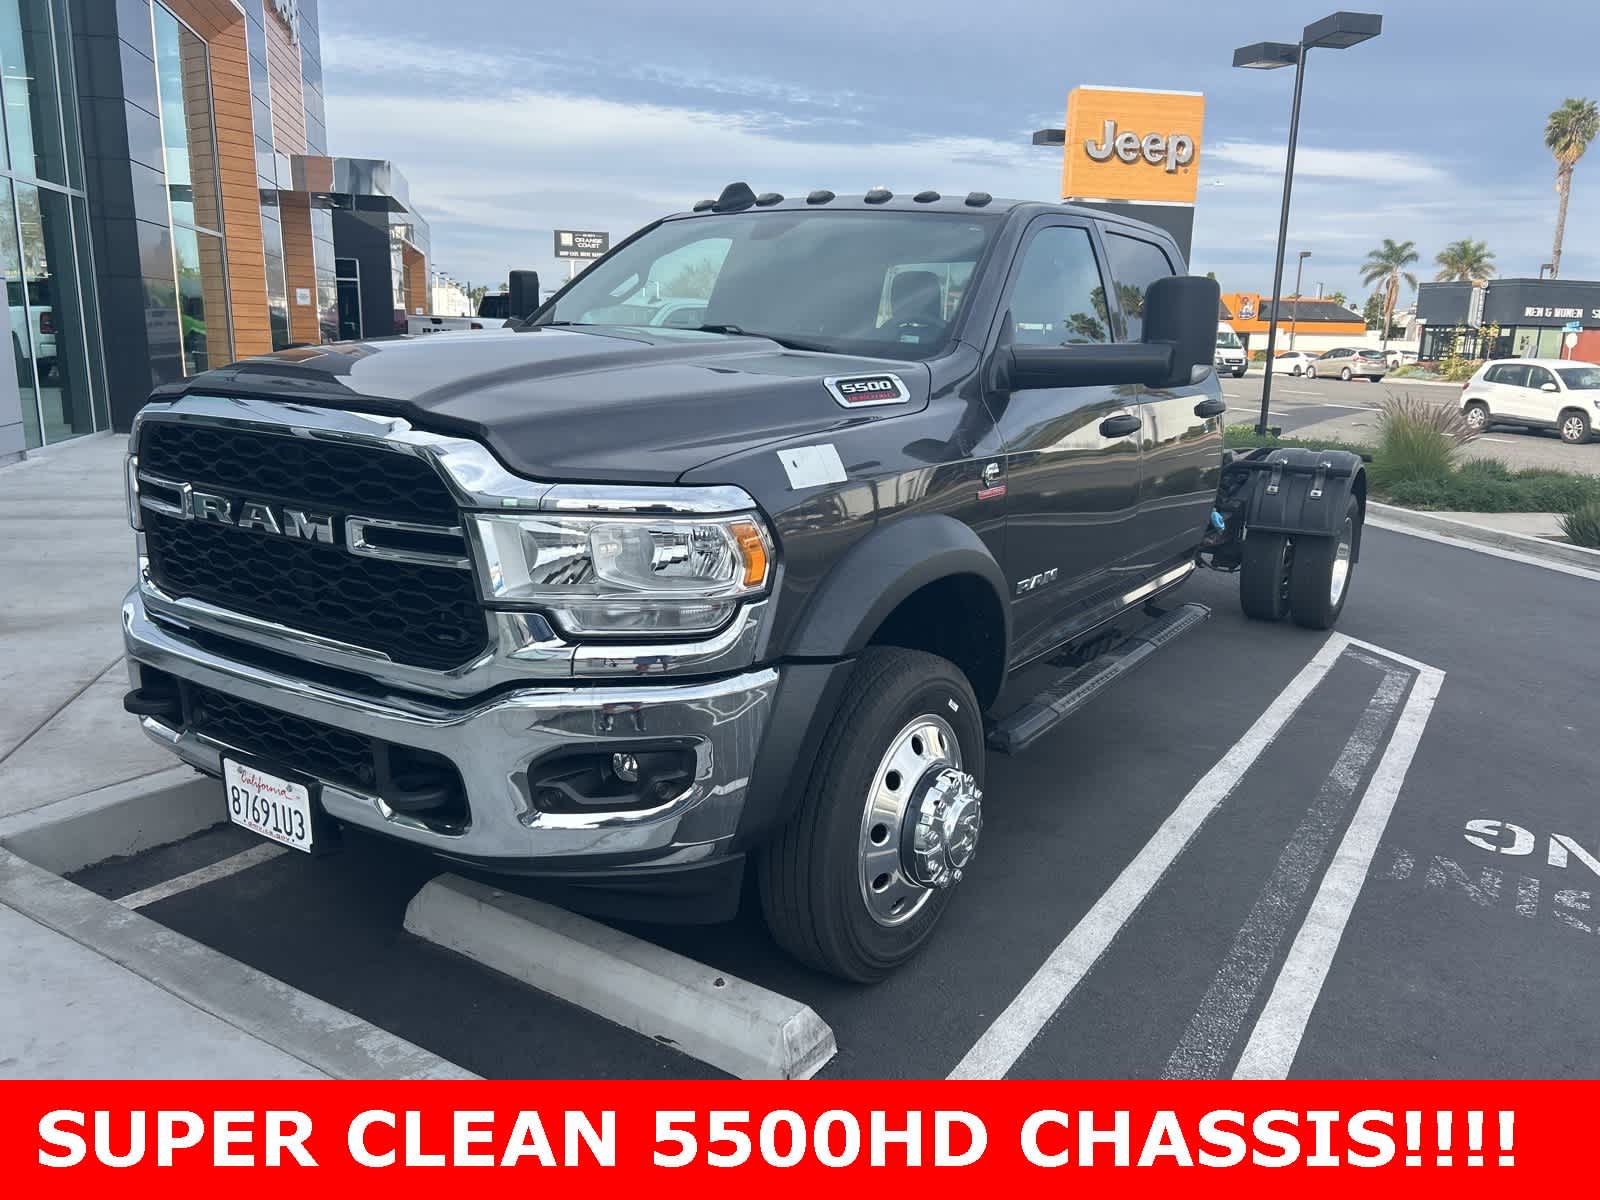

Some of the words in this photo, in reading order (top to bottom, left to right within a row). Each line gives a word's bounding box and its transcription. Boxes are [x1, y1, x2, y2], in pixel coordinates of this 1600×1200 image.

[1085, 119, 1194, 174] Jeep
[841, 380, 892, 393] 5500
[193, 491, 334, 544] RAM
[1016, 567, 1058, 595] RAM
[240, 769, 292, 799] California
[231, 785, 305, 840] 87691U3
